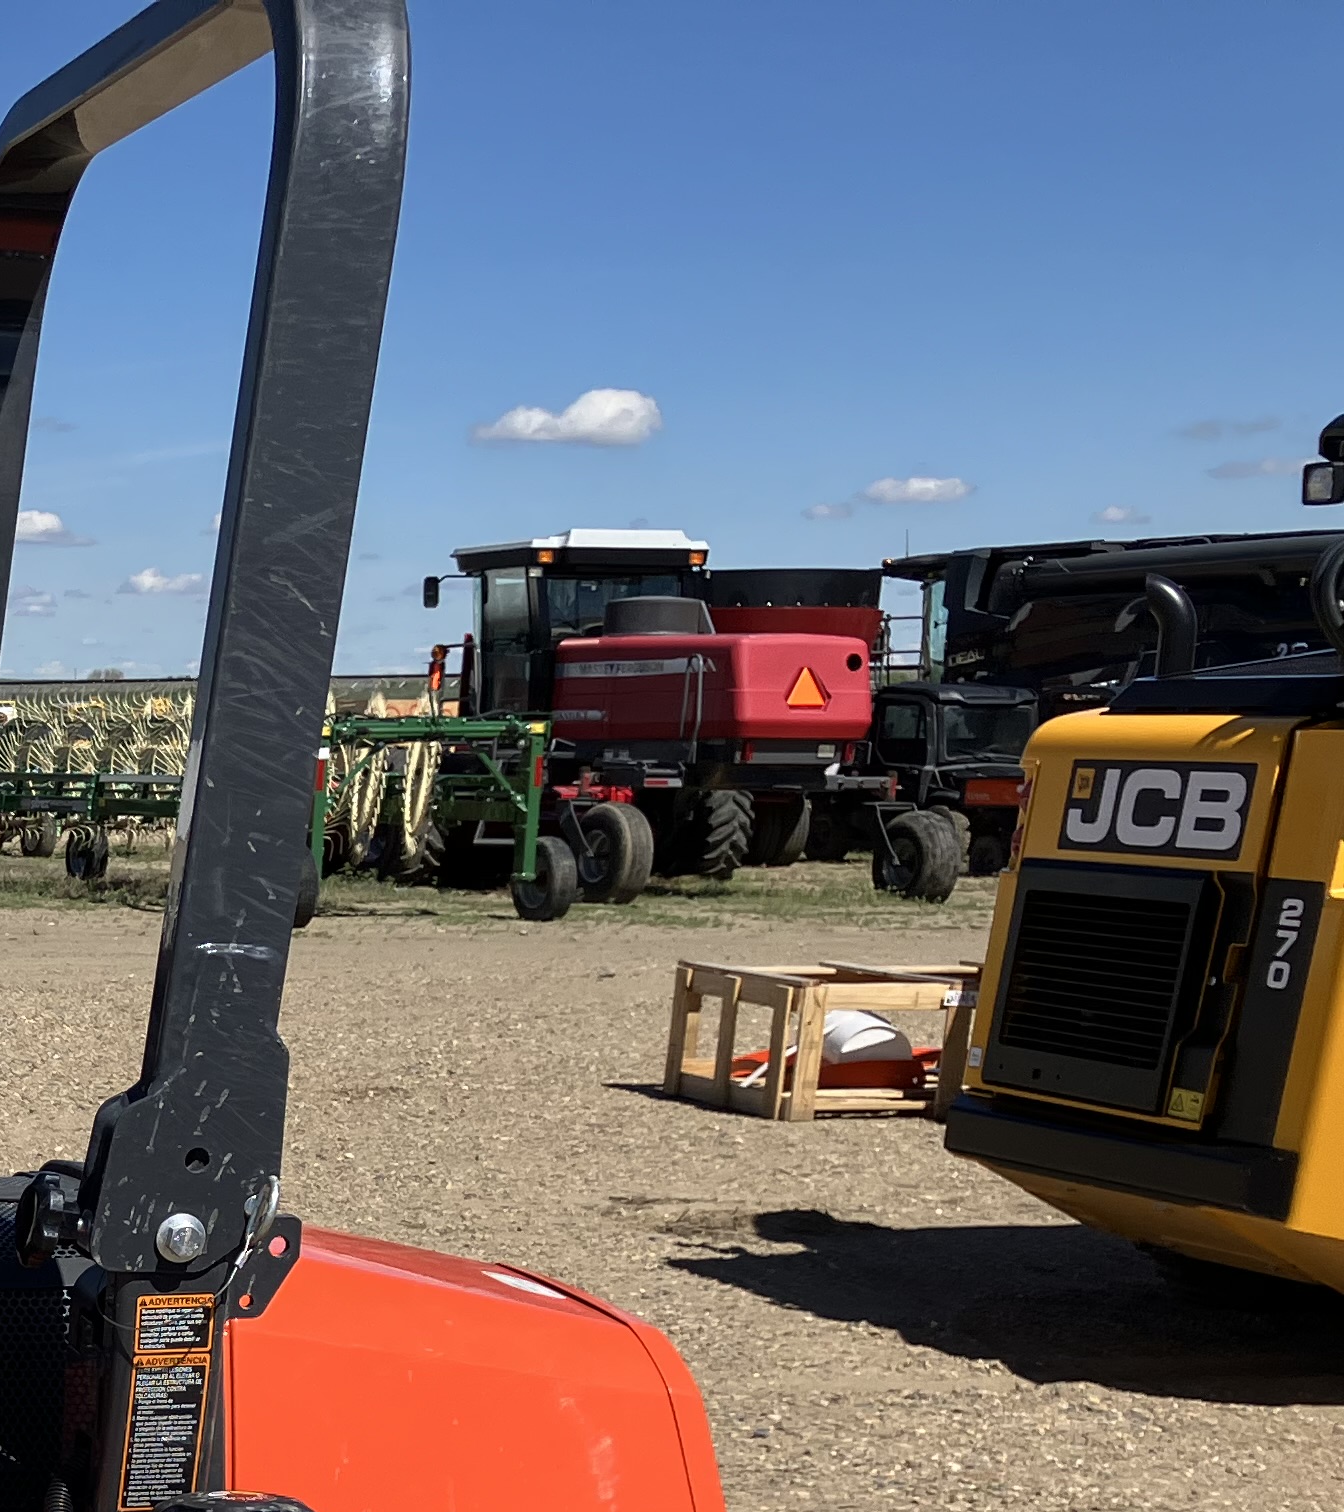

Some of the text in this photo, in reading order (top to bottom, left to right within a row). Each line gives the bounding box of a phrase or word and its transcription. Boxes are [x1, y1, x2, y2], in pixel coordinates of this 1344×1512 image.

[1066, 768, 1248, 850] JCB
[1266, 898, 1305, 990] 270
[148, 1296, 214, 1306] ADVERTENCIA
